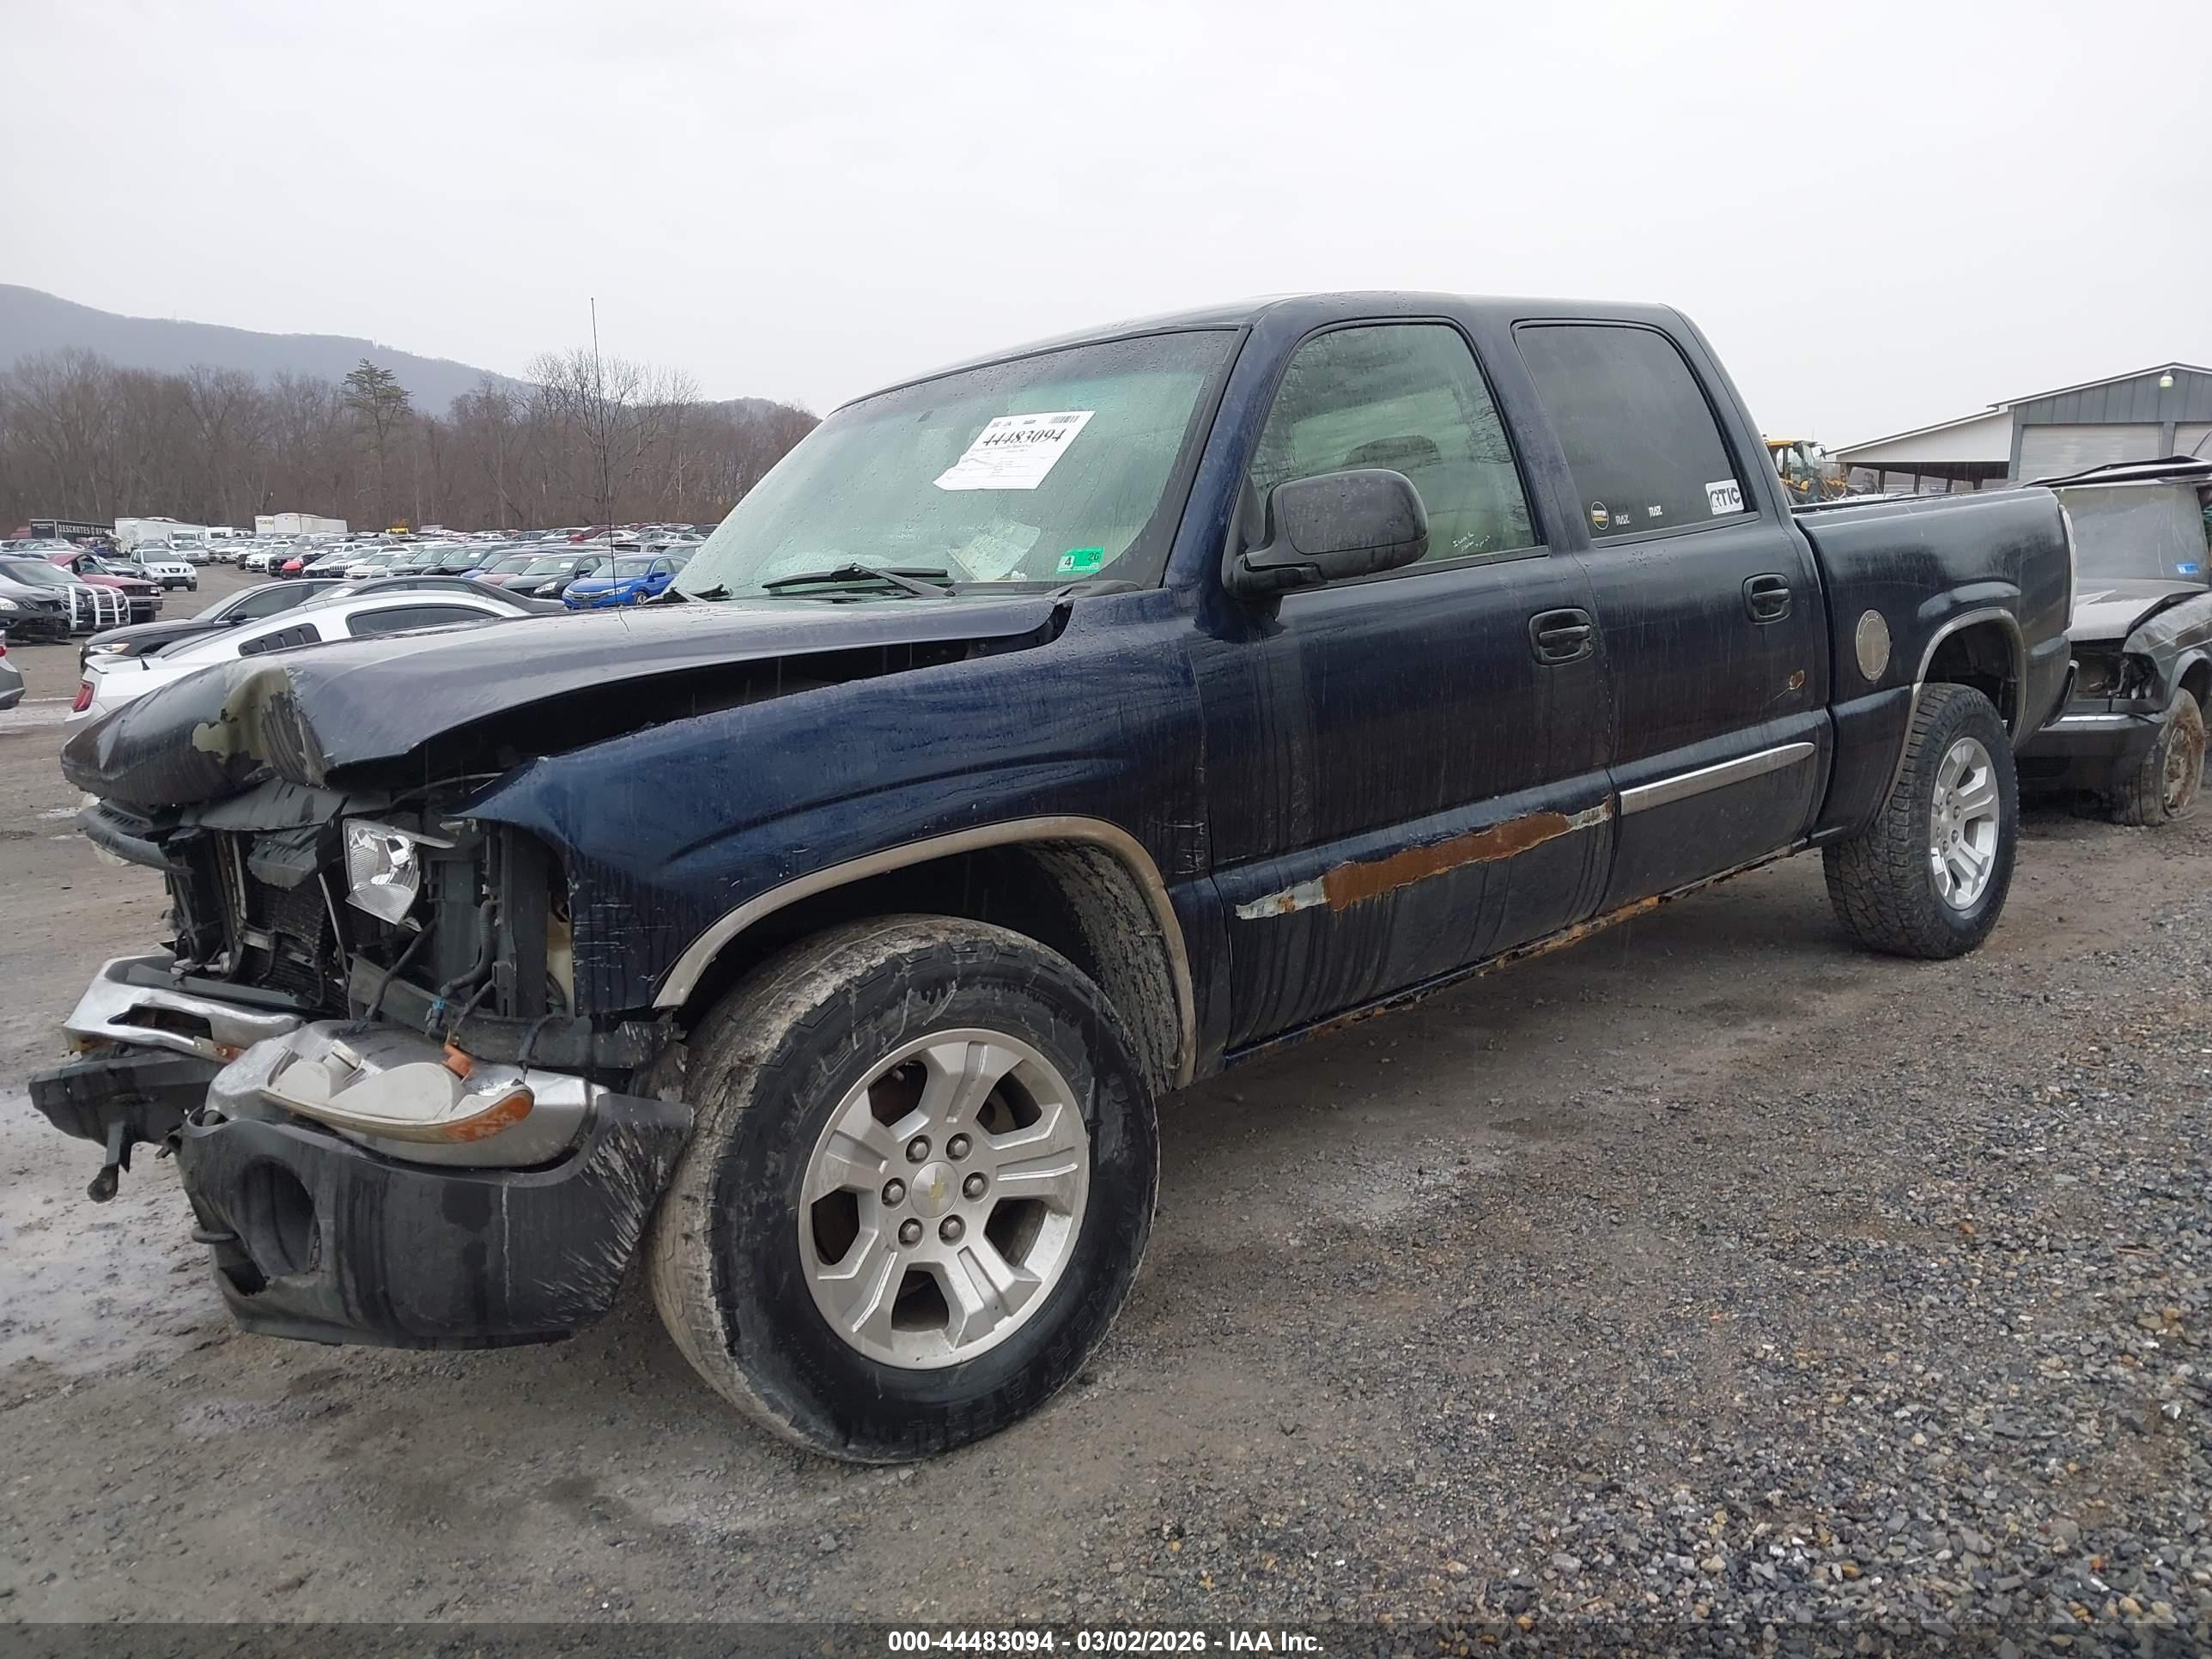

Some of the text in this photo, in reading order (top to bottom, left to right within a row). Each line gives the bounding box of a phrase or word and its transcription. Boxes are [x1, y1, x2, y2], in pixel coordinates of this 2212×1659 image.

[982, 428, 1066, 447] 44483094
[1710, 487, 1740, 507] RTIC
[1064, 556, 1072, 567] 4
